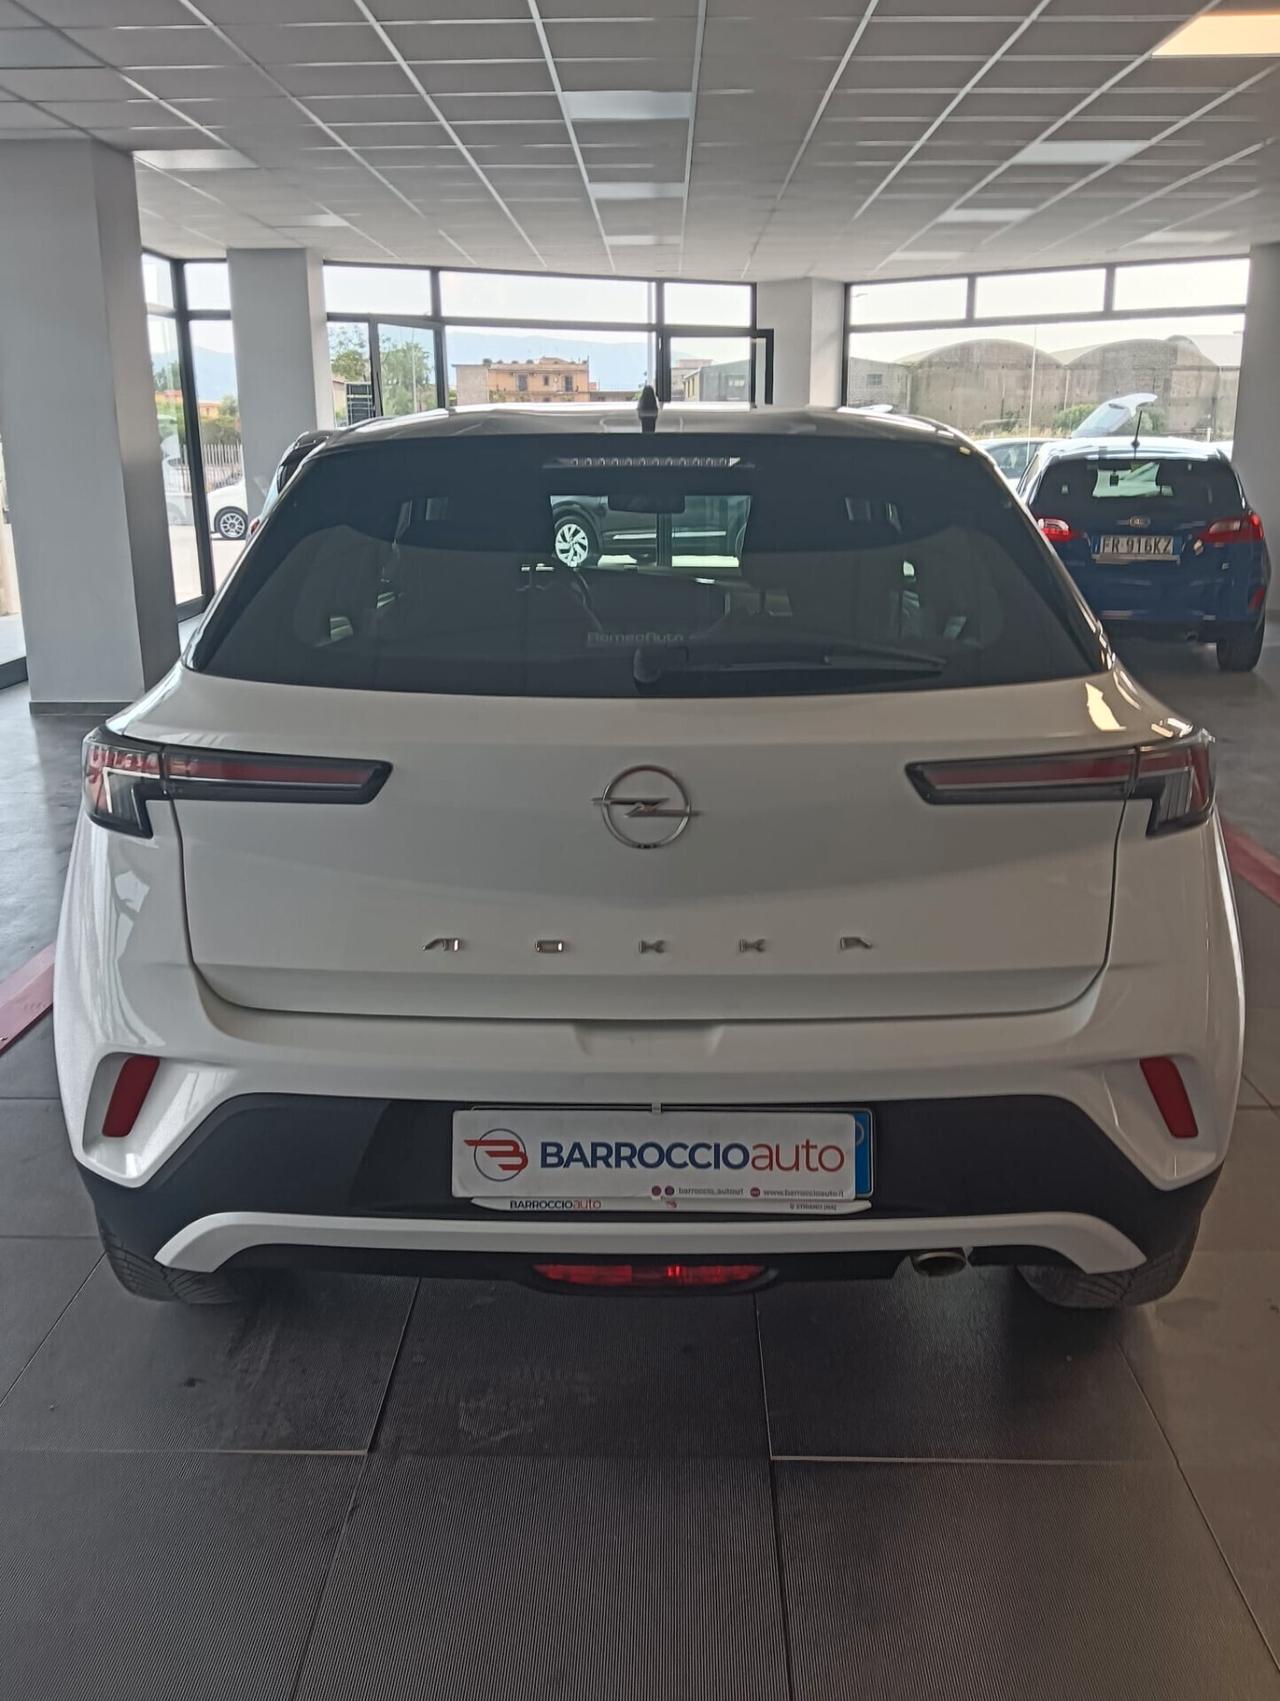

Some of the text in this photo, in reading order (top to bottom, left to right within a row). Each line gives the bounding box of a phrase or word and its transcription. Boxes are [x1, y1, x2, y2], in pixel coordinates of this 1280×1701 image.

[1102, 536, 1172, 554] FR 916KZ
[539, 1138, 846, 1172] BARROCCIOauto
[509, 1199, 602, 1210] BARROCCIOauto
